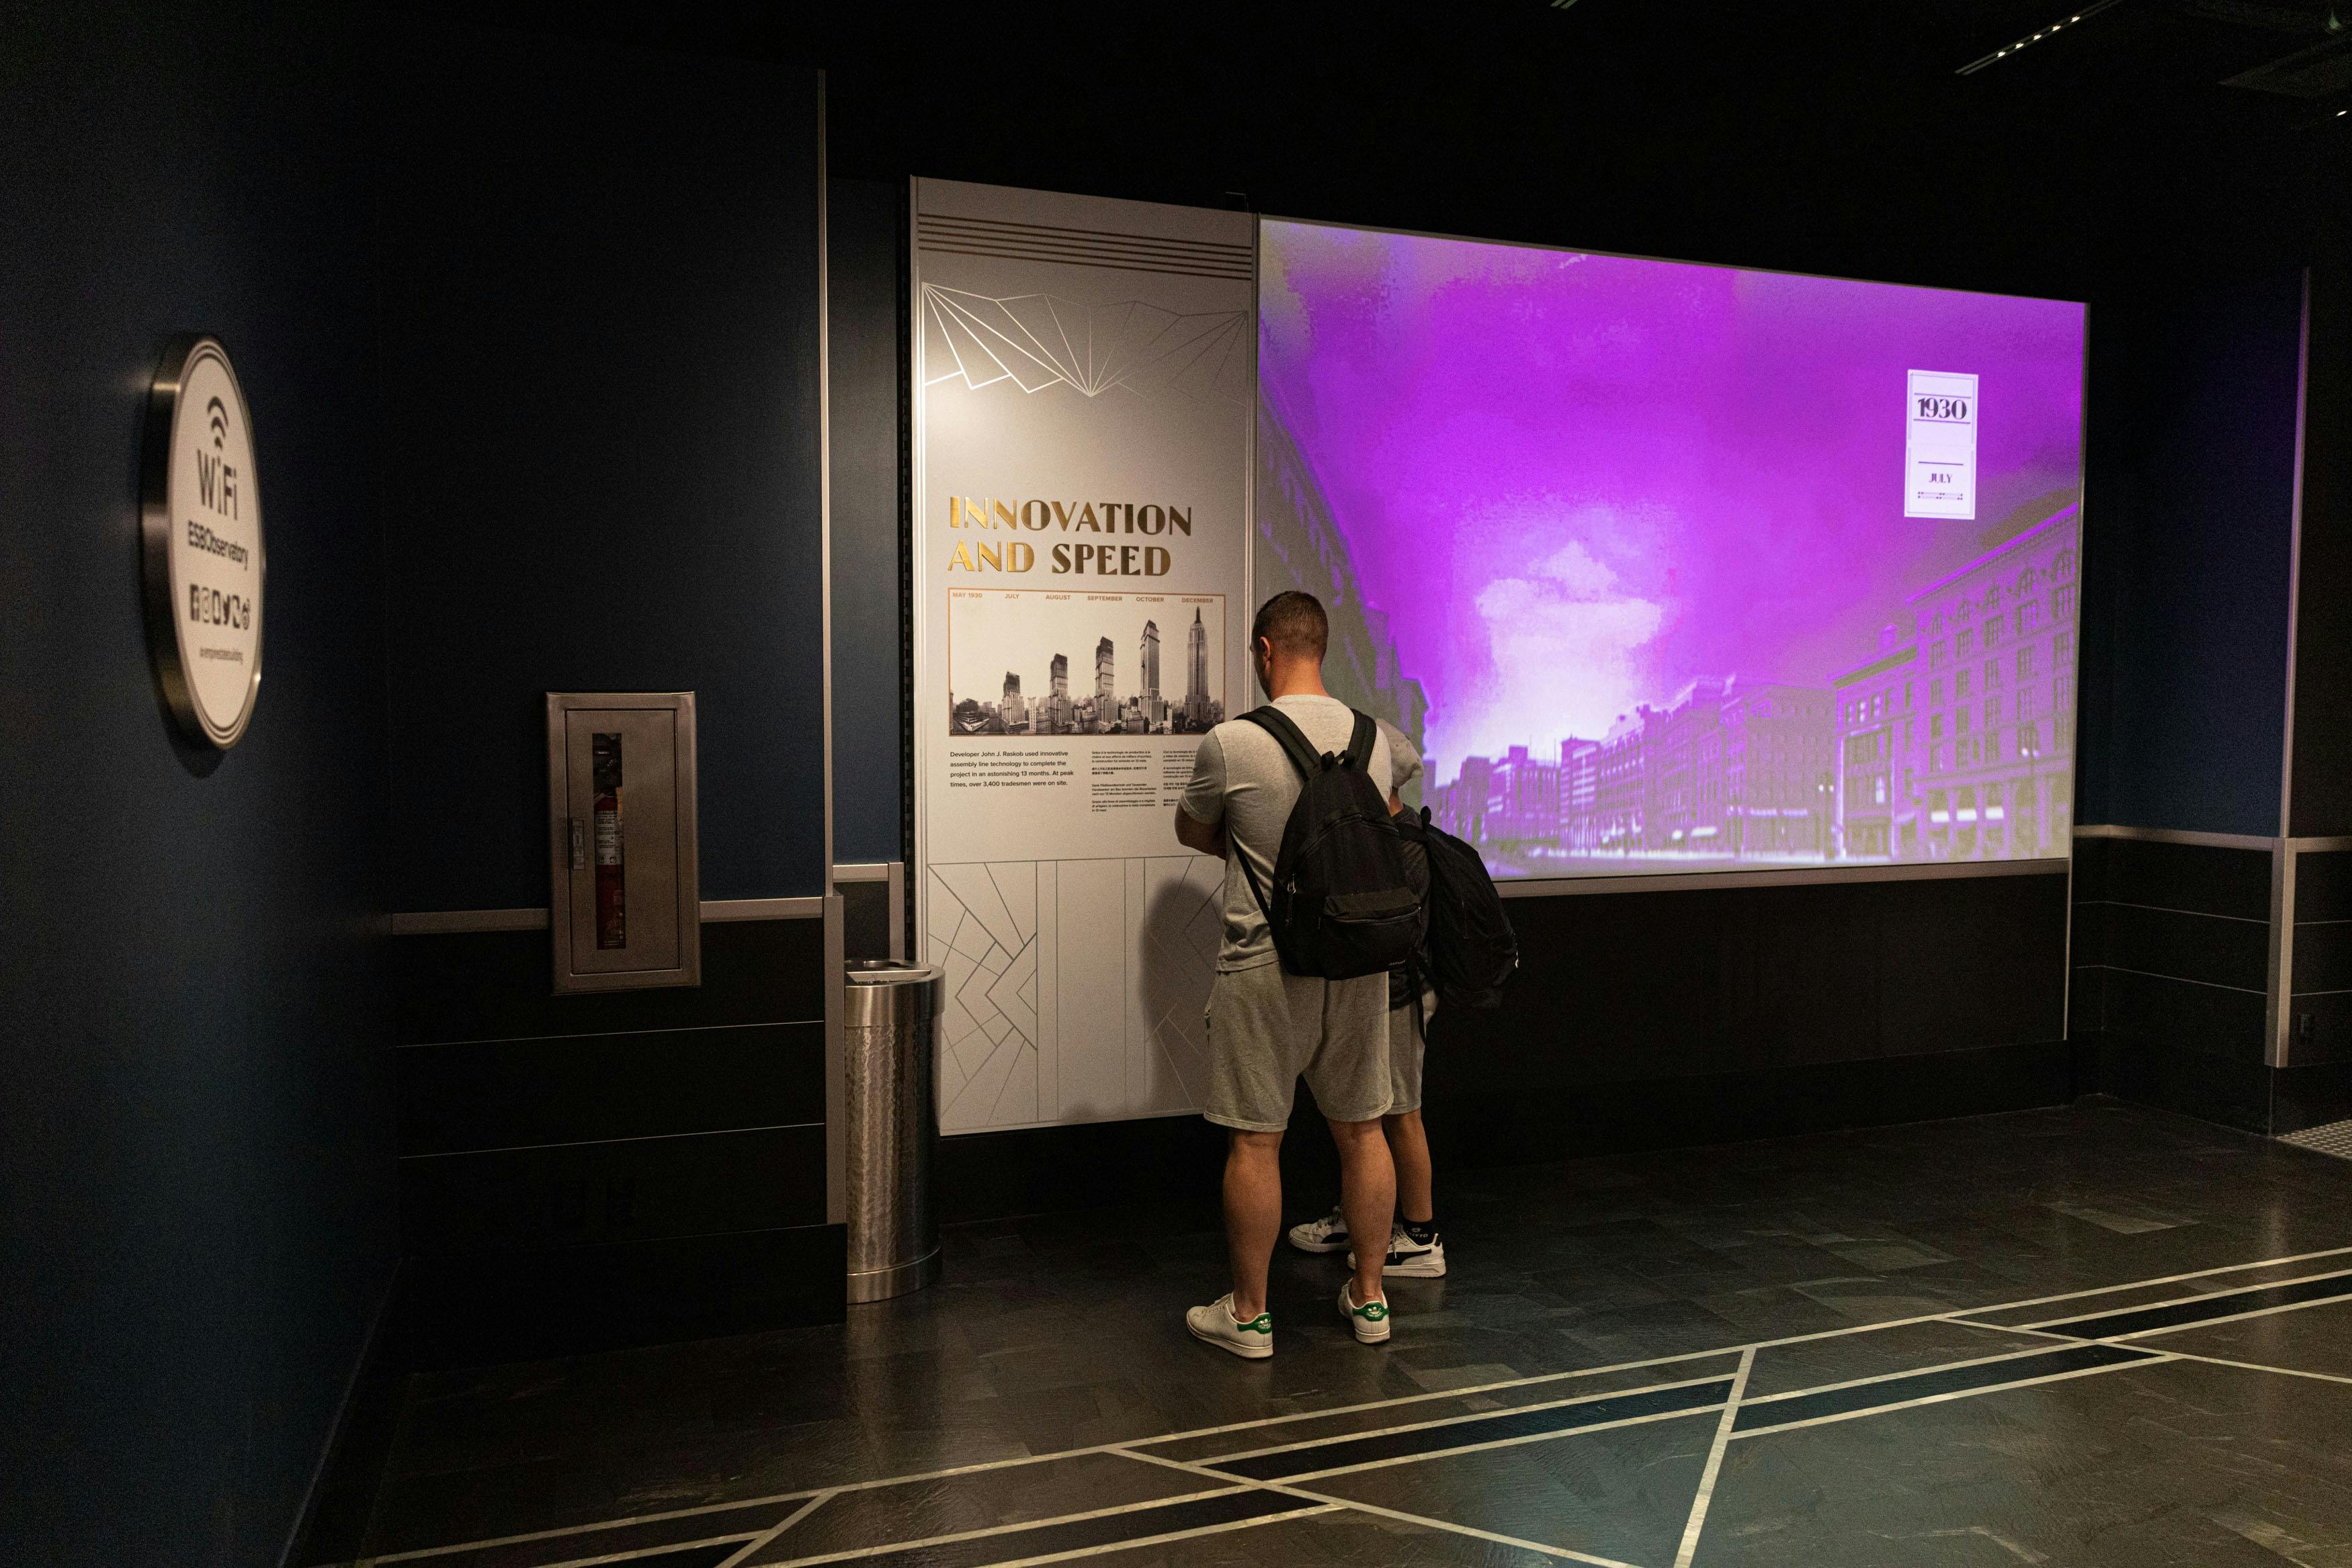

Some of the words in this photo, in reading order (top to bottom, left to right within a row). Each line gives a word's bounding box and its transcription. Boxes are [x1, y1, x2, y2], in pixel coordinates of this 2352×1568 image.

[1917, 397, 1967, 420] 1930
[197, 448, 237, 521] WiFi
[1929, 473, 1952, 484] JULY
[950, 496, 1191, 536] INNOVATION
[188, 519, 249, 570] ESBObservatory
[948, 541, 1035, 573] AND
[1052, 543, 1171, 576] SPEED
